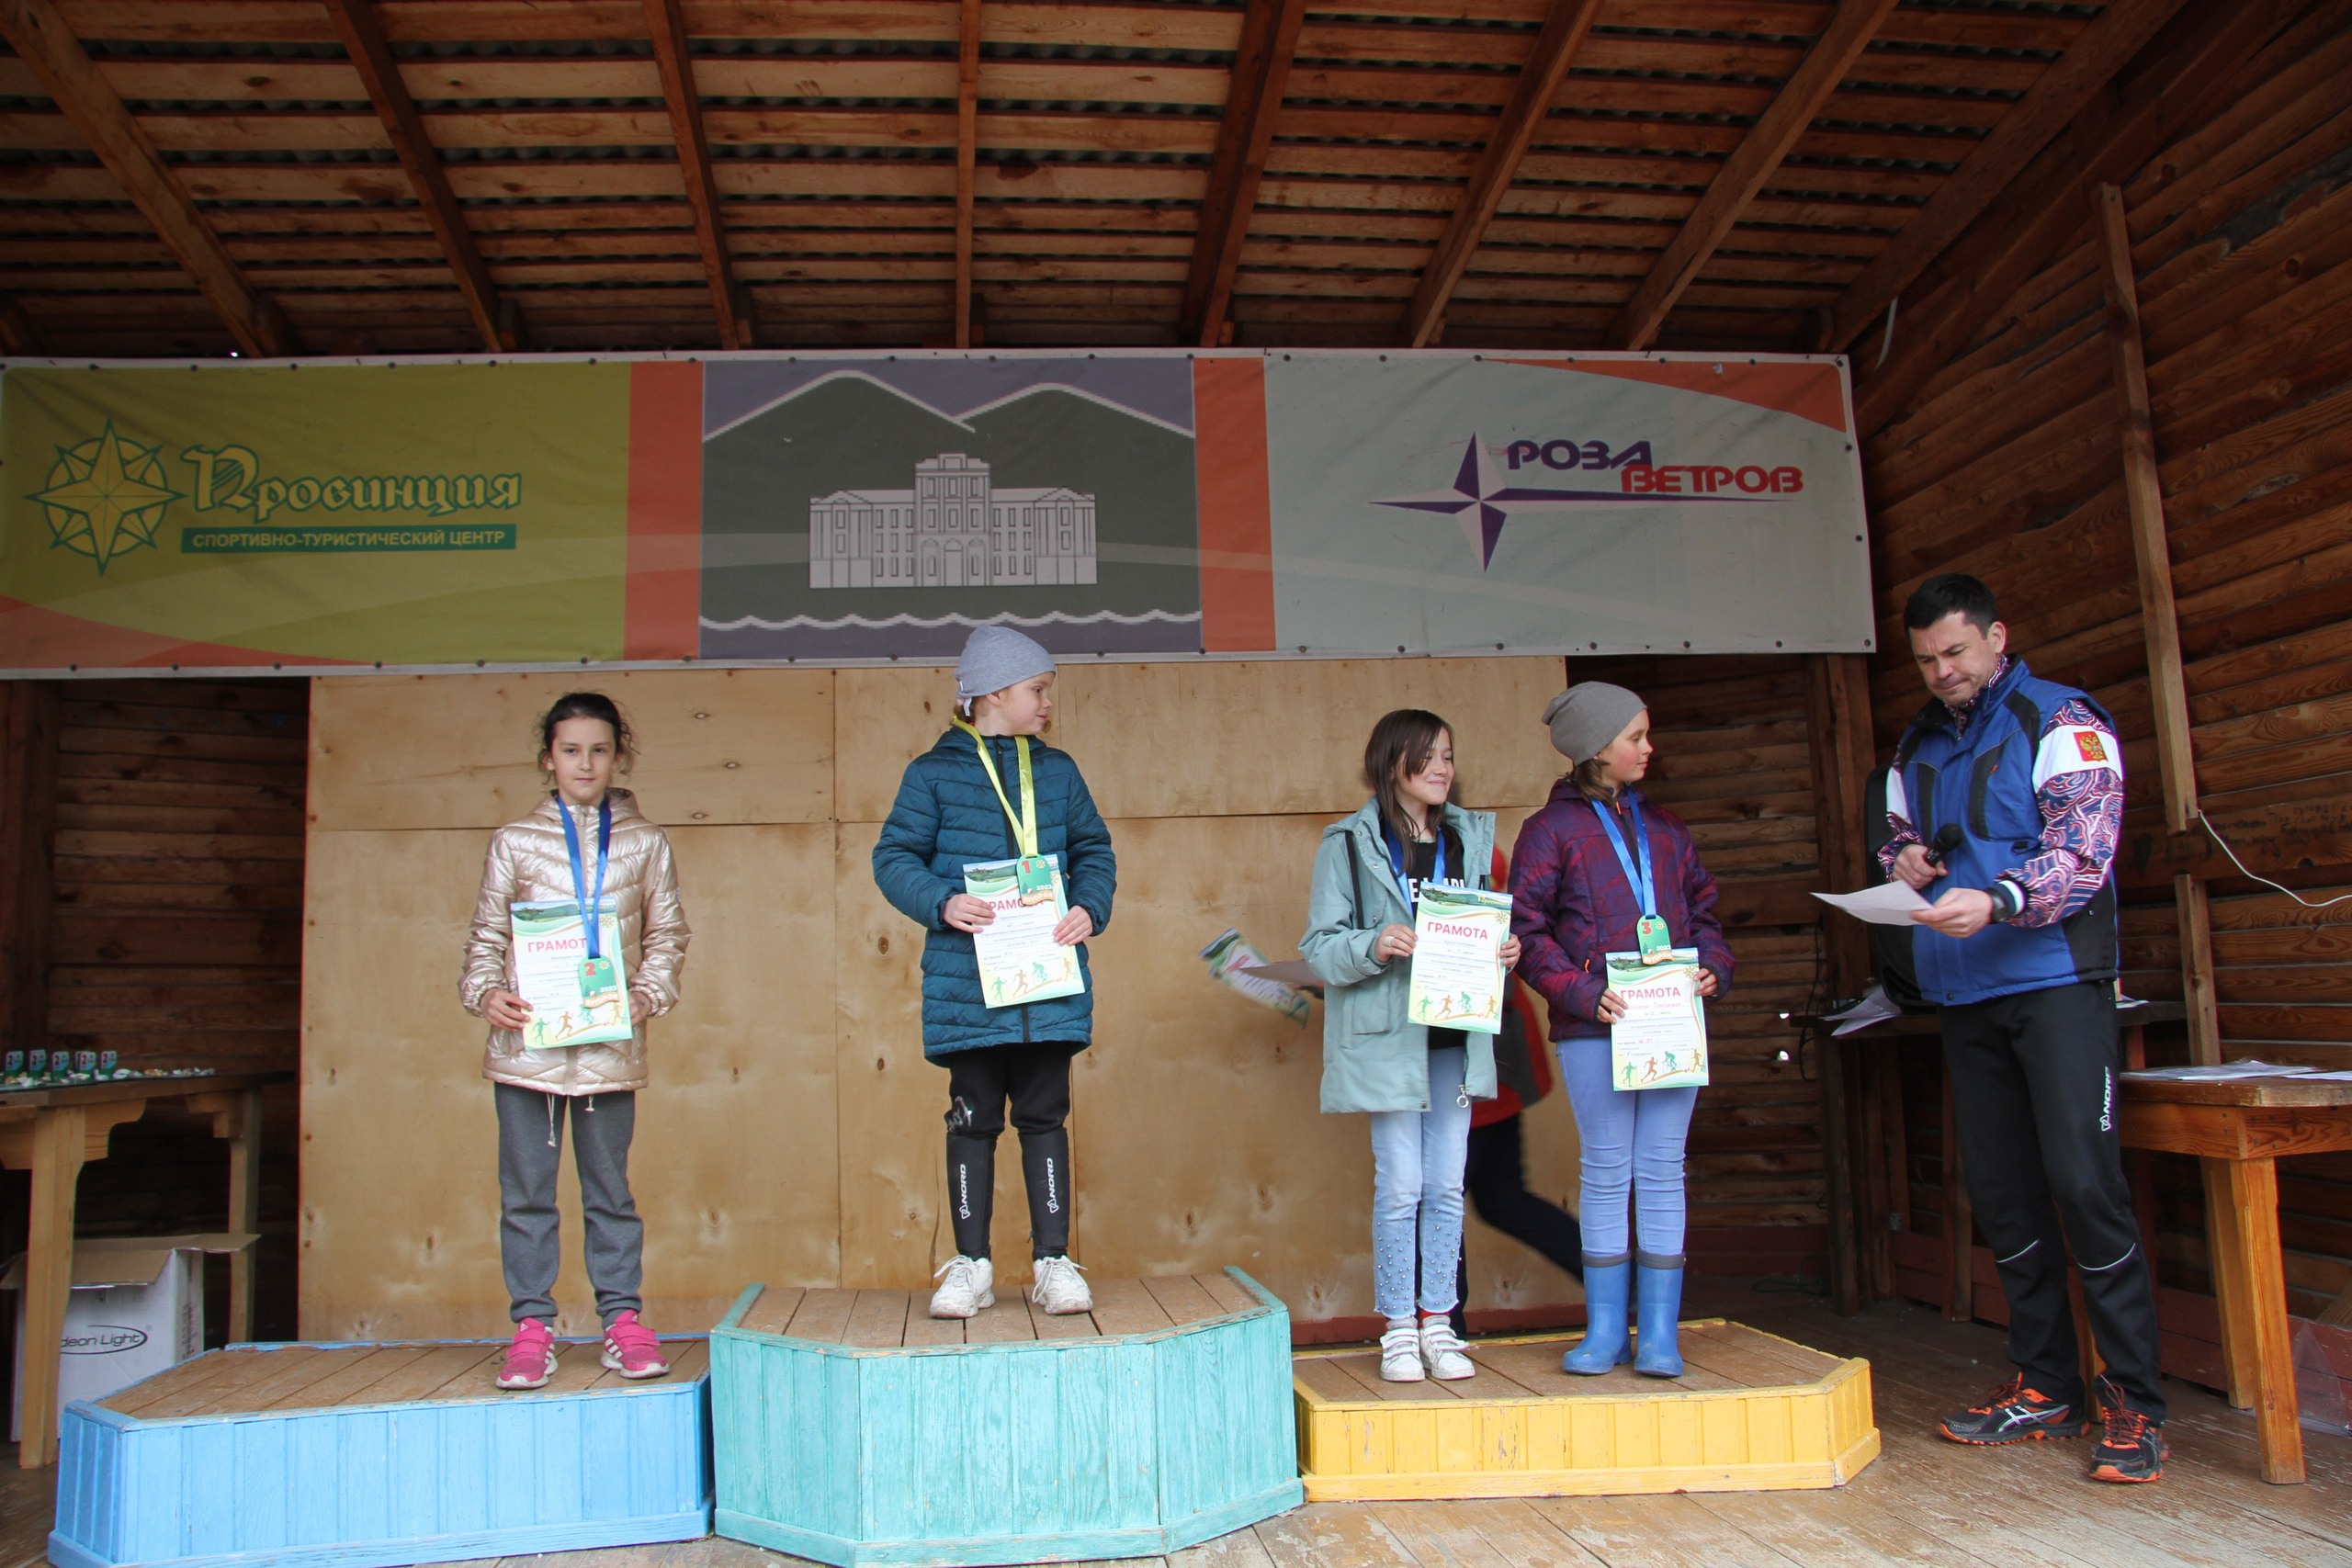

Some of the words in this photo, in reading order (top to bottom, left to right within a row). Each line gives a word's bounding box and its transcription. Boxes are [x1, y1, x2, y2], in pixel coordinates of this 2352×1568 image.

[1508, 439, 1653, 470] РОЗА
[180, 444, 522, 524] Провинция
[1621, 464, 1804, 493] ВЕТРОВ
[192, 529, 445, 548] СПОРТИВНО-ТУРИСТИЧЕСКИЙ
[449, 530, 505, 547] ЦЕНТР
[1021, 861, 1031, 874] 1
[1428, 921, 1487, 940] ГРАМОТА
[1641, 921, 1652, 934] 3
[527, 938, 587, 953] ГРАМОТ
[583, 962, 596, 976] 2
[1621, 987, 1681, 1000] ГРАМОТА
[1046, 1157, 1056, 1200] NORD
[60, 1337, 96, 1348] deon
[100, 1334, 141, 1348] Light
